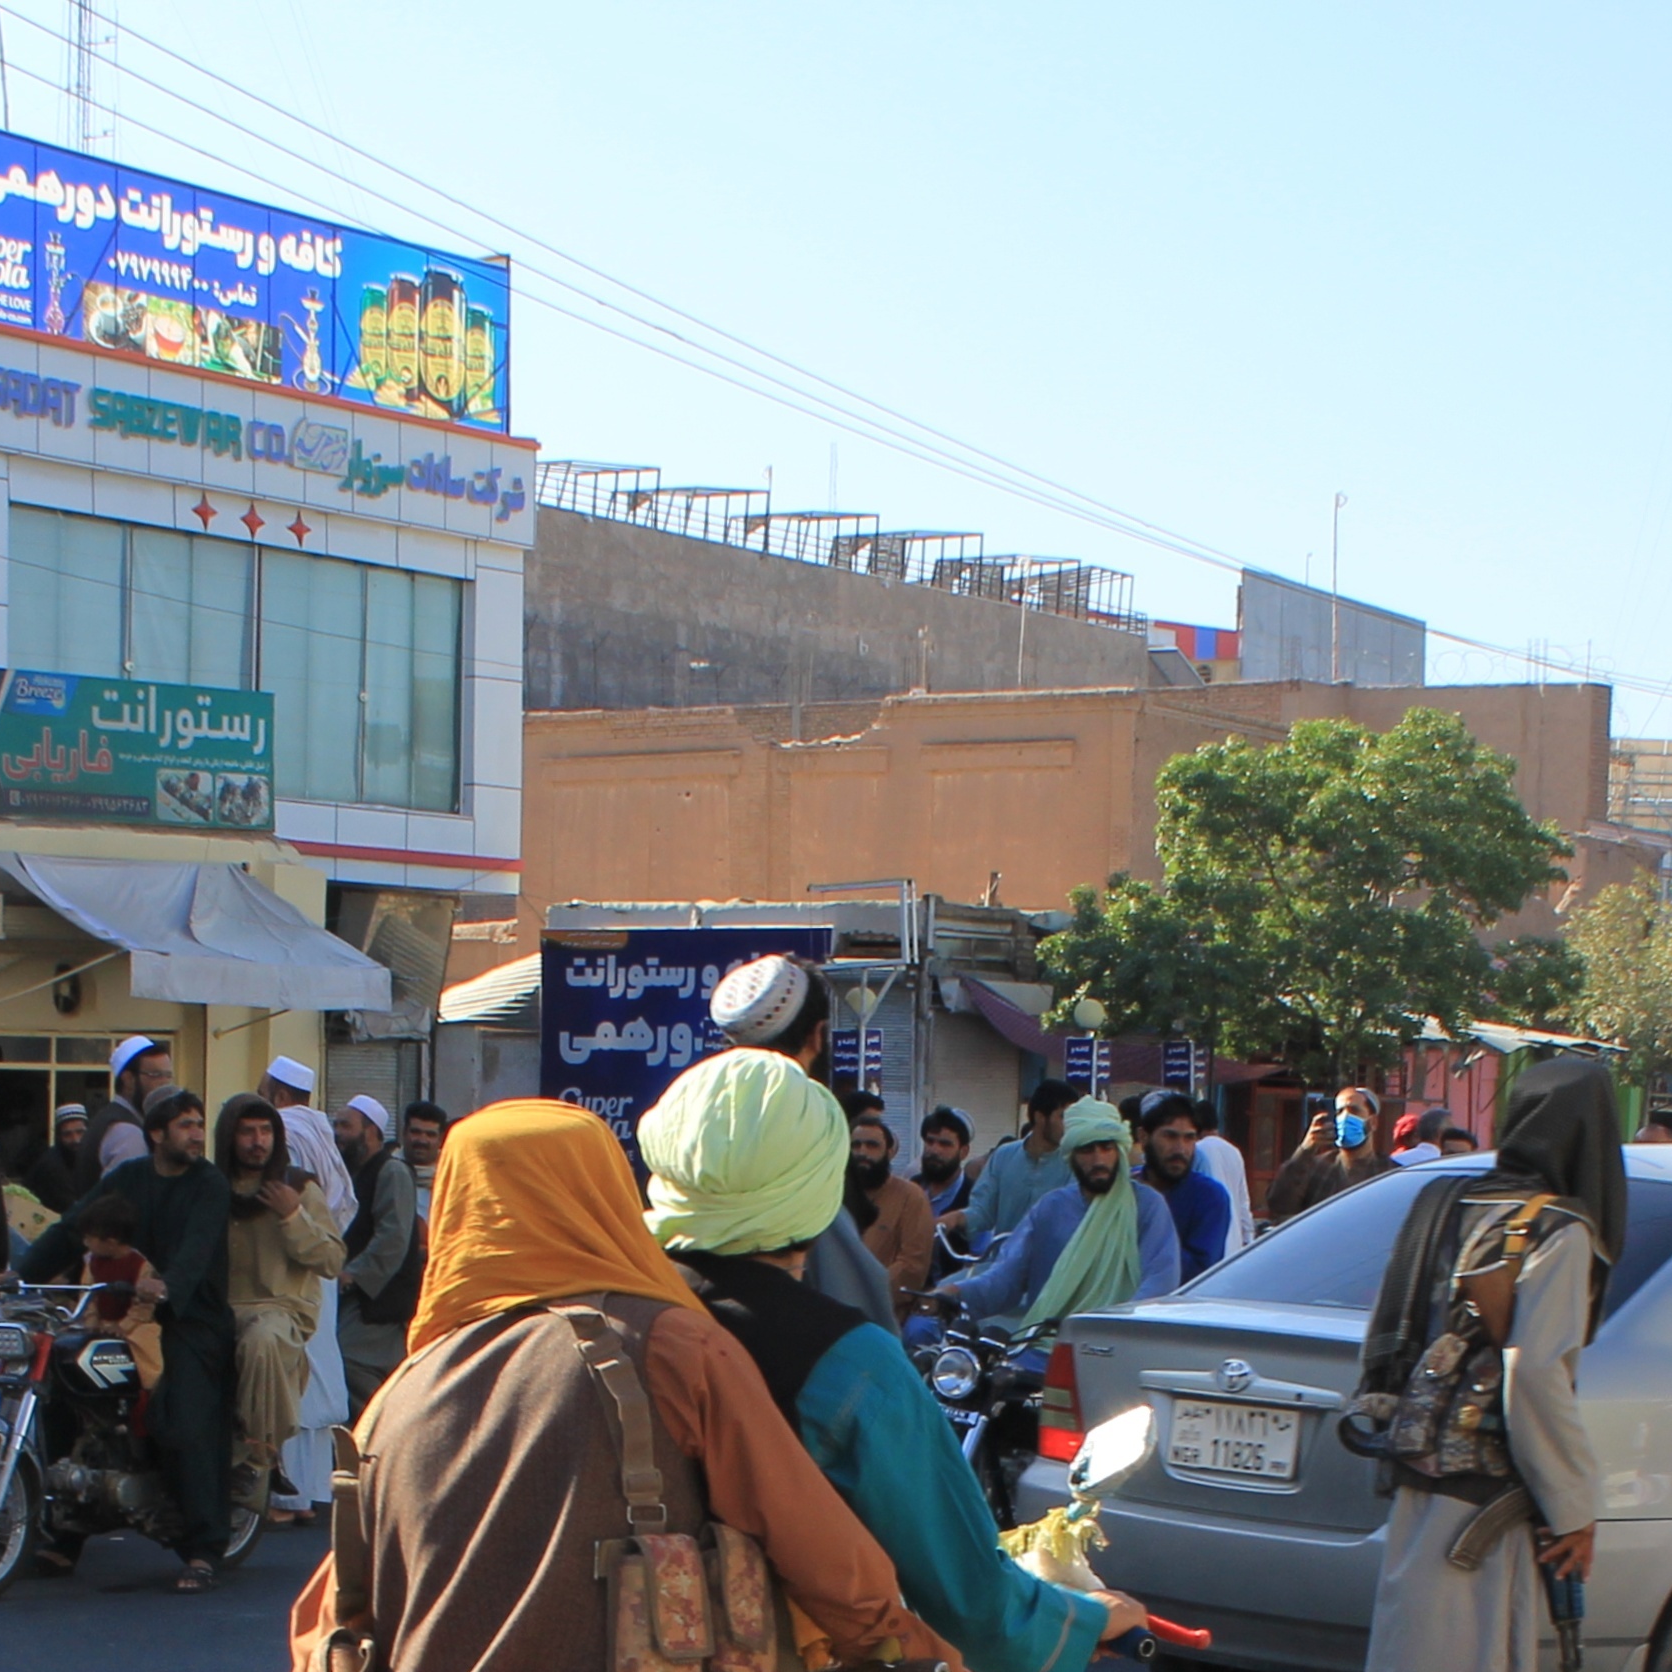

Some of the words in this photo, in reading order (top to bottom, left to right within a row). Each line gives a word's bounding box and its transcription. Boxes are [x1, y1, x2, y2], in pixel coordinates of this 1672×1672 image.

[120, 187, 253, 269] رستورانت
[257, 233, 276, 275] و
[280, 231, 342, 278] کافه
[89, 386, 242, 461] SABZEWAR
[92, 685, 265, 755] رستورانت
[2, 727, 113, 782] فاریابی
[566, 955, 696, 999] رستورانت
